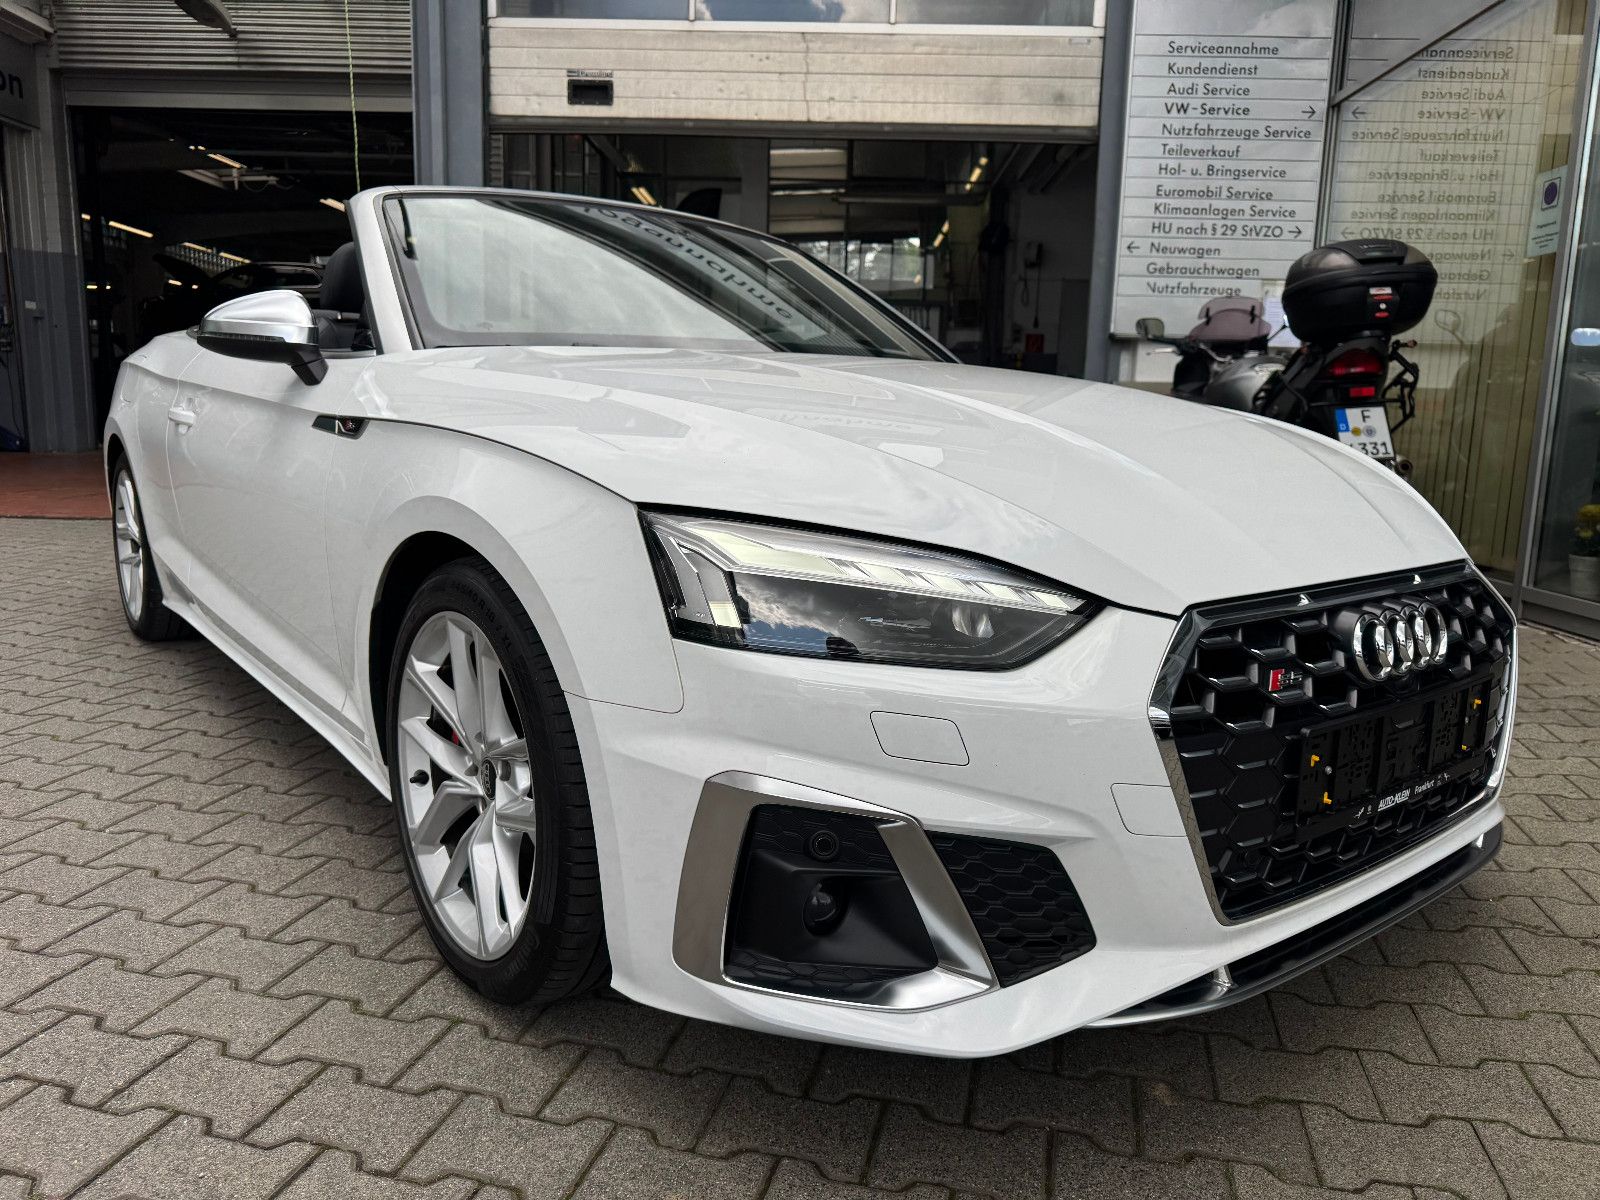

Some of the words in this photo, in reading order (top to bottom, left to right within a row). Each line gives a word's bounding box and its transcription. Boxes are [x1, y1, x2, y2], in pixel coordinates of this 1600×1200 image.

[1167, 41, 1279, 56] Serviceannahme
[1167, 62, 1258, 76] Kundendienst
[1167, 83, 1199, 96] Audi
[1202, 83, 1250, 97] Service
[1161, 123, 1260, 140] Nutzfahrzeuge
[1263, 125, 1312, 139] Service
[1161, 143, 1241, 158] Teileverkauf
[1158, 163, 1187, 176] Hol-
[1191, 167, 1203, 177] u.
[1206, 165, 1287, 180] Bringservice
[1155, 184, 1222, 199] Euromobil
[1226, 186, 1273, 200] Service
[1153, 203, 1245, 220] Klimaanlagen
[1249, 204, 1296, 219] Service
[1151, 222, 1172, 235] HU
[1176, 223, 1207, 236] nach
[1210, 225, 1218, 237] §
[1220, 224, 1237, 237] 29
[1241, 224, 1283, 238] StVZO
[1149, 242, 1221, 259] Neuwagen
[1146, 262, 1260, 279] Gebrauchtwagen
[1361, 409, 1371, 423] F
[1358, 441, 1391, 456] 331
